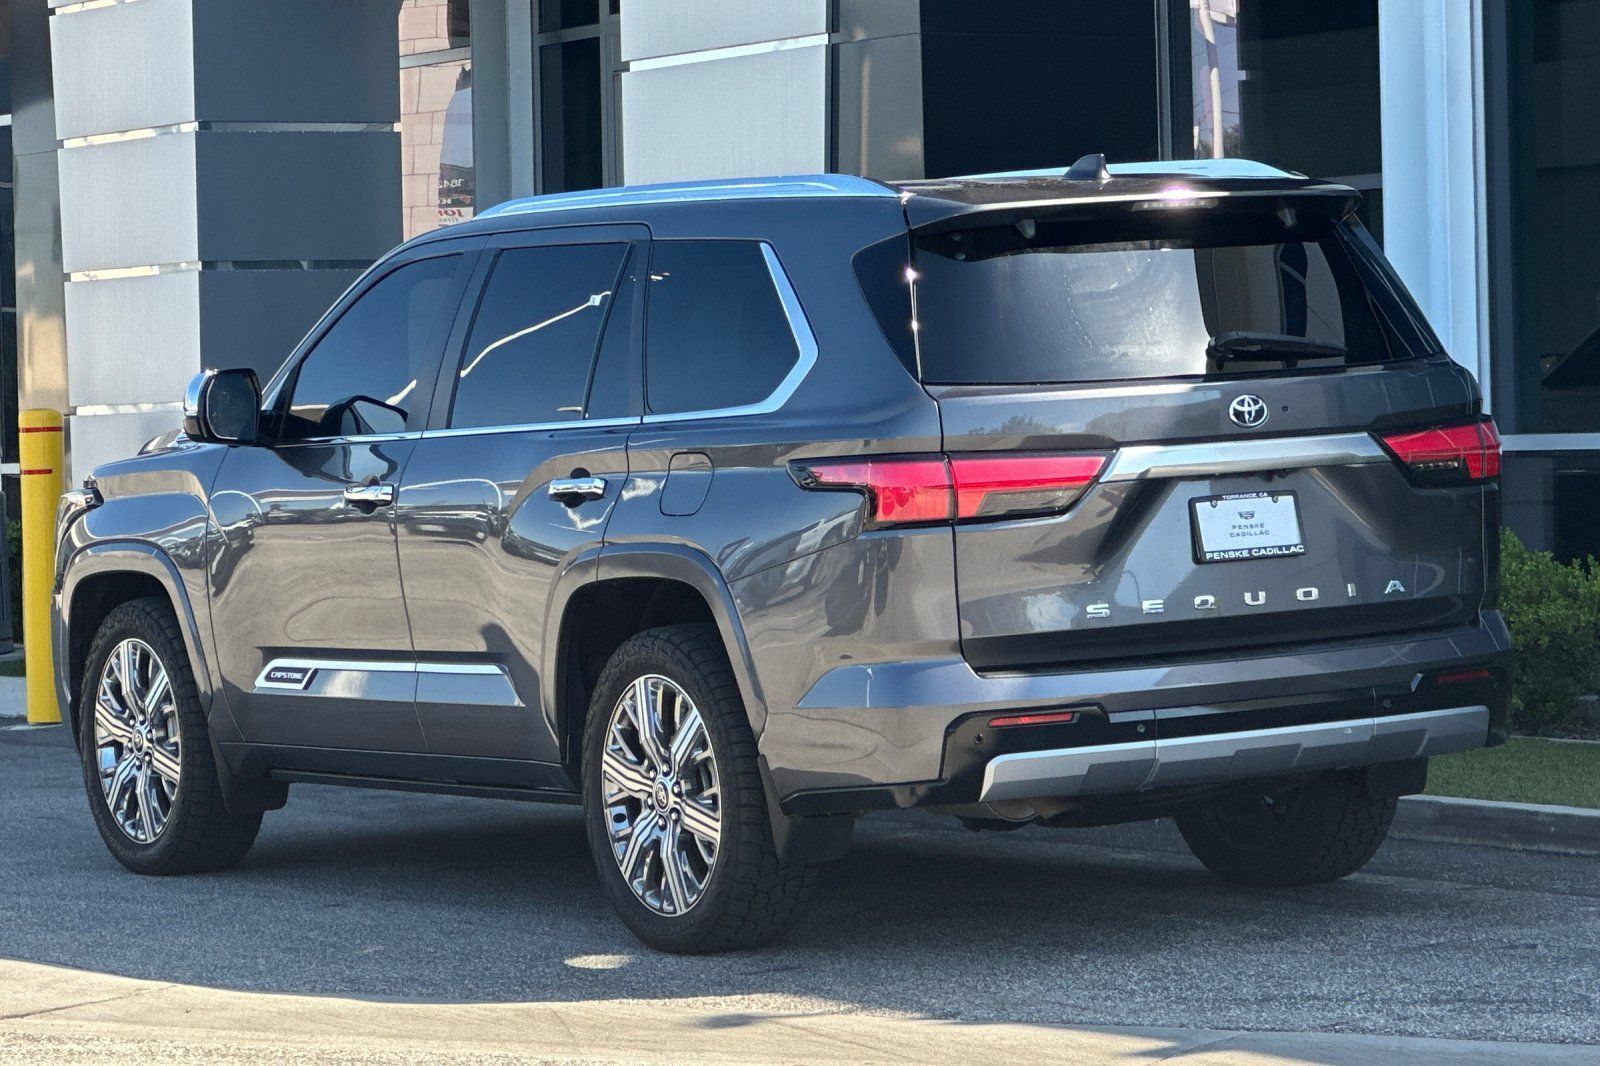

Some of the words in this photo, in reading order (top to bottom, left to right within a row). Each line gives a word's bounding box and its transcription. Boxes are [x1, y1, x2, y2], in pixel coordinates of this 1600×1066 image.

[1232, 522, 1265, 530] PENSKE
[1229, 530, 1270, 538] CADILLAC
[1206, 549, 1250, 560] PENSKE
[1251, 545, 1305, 556] CADILLAC
[1086, 579, 1406, 619] SEQUOIA
[270, 671, 304, 680] CAPSTONE
